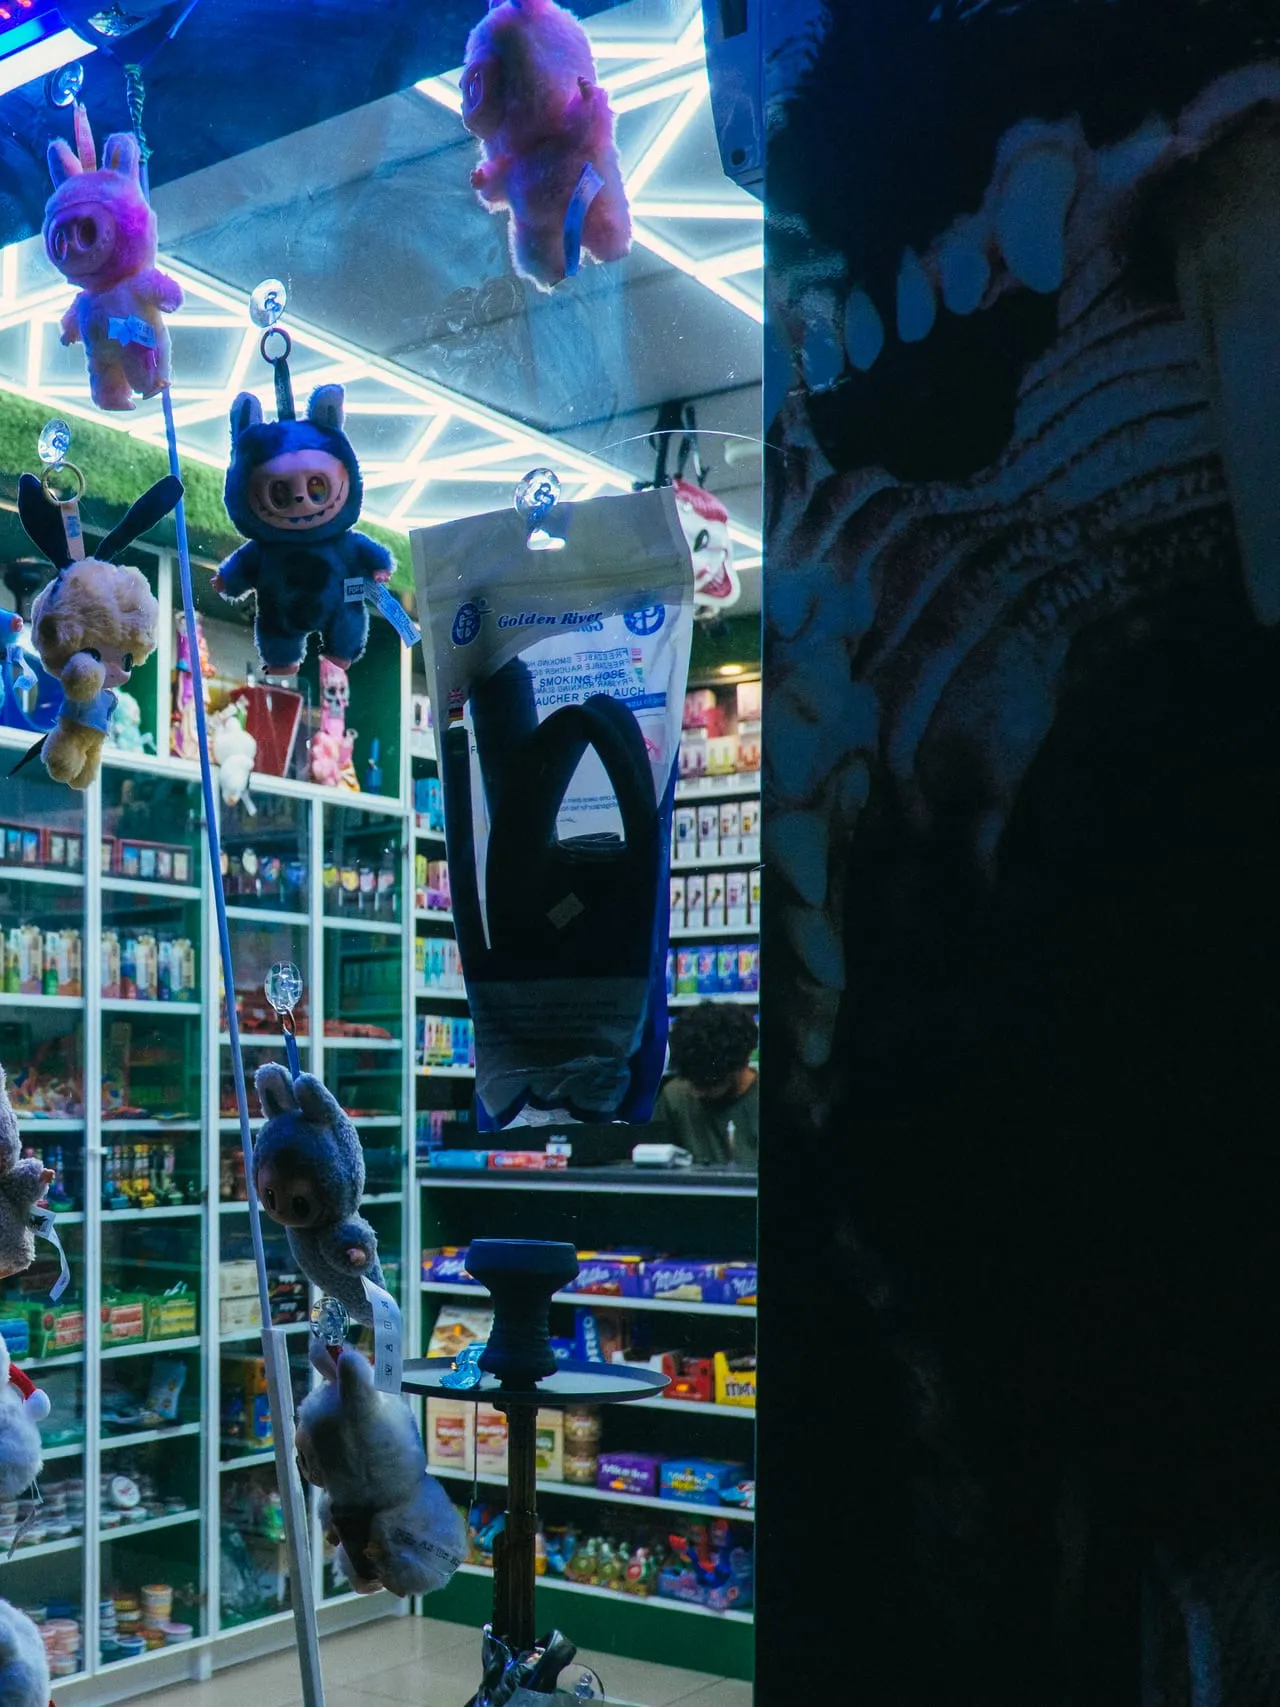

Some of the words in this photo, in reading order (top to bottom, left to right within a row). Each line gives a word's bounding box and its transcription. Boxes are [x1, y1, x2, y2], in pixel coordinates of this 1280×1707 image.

[498, 612, 556, 629] Golden
[560, 611, 603, 626] River
[539, 674, 591, 688] SMOKING
[595, 668, 626, 682] HOSE
[535, 692, 579, 706] AUCHER
[651, 1269, 695, 1292] Milka
[732, 1277, 757, 1297] Mil
